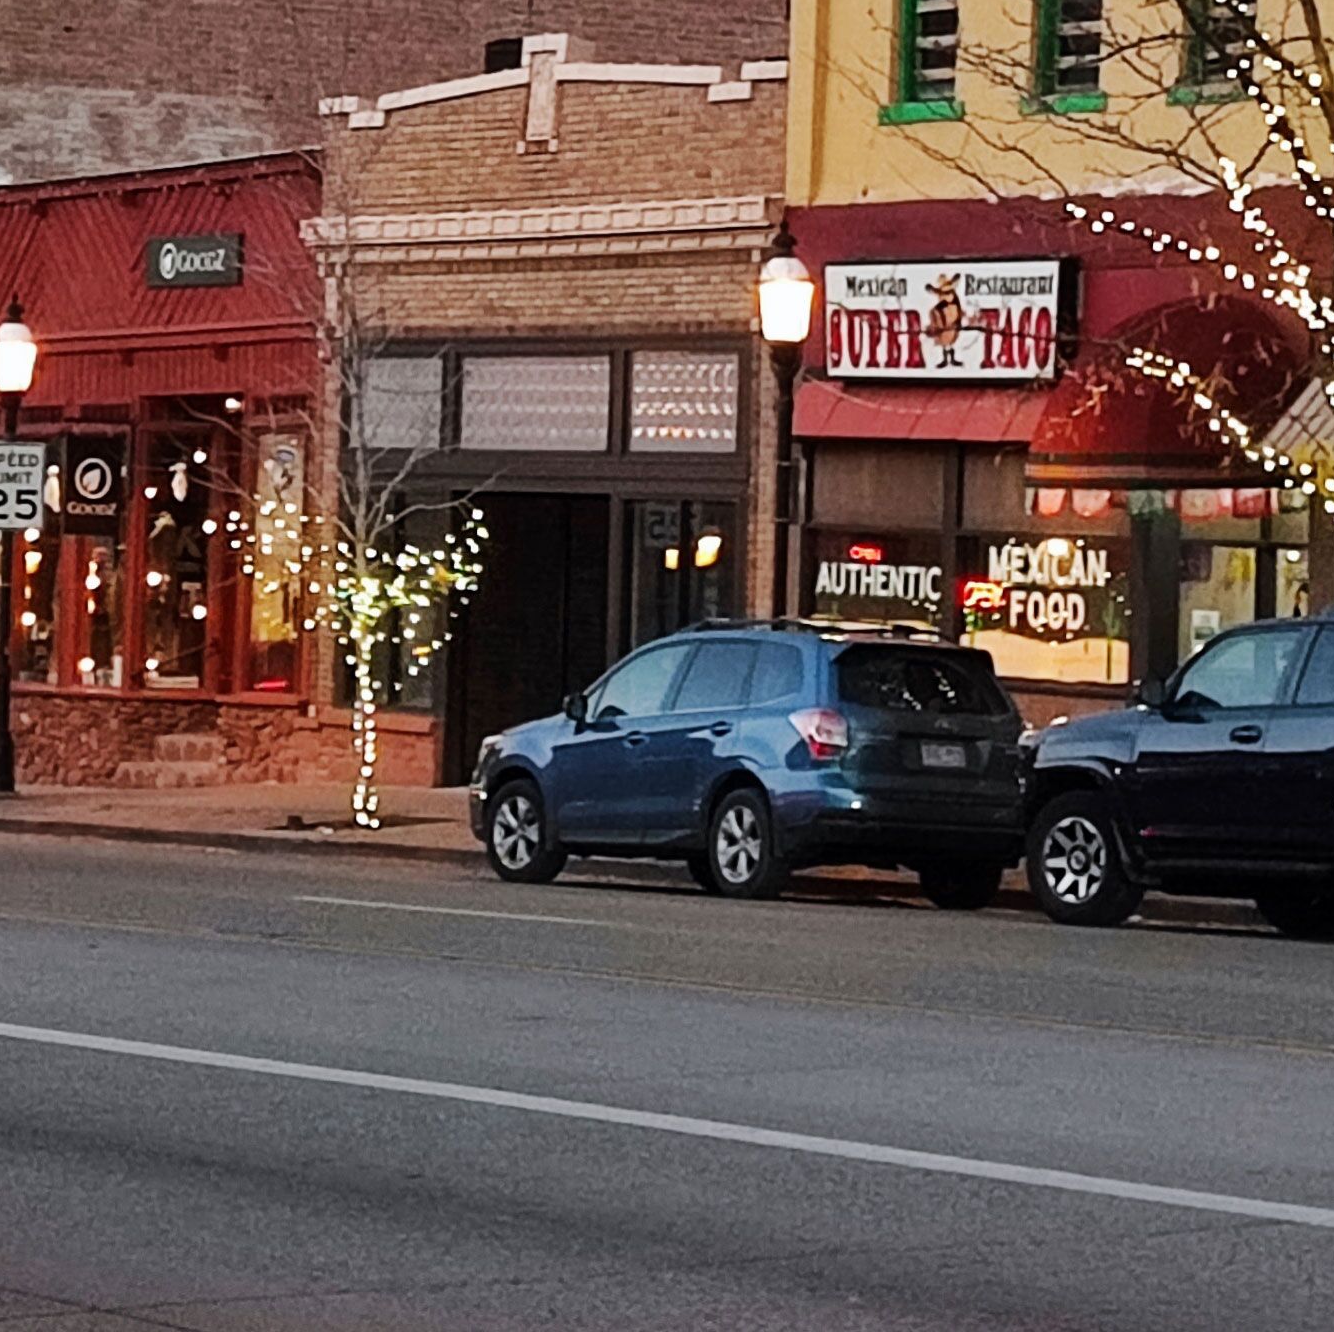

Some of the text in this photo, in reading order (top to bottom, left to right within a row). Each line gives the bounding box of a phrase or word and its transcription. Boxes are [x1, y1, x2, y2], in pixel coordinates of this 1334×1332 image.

[845, 272, 1055, 298] Mexican Restaurant
[830, 306, 1052, 369] SUPER TACO
[814, 561, 943, 601] AUTHENTIC
[987, 544, 1109, 587] MEXICAN
[1009, 589, 1086, 630] FOOD
